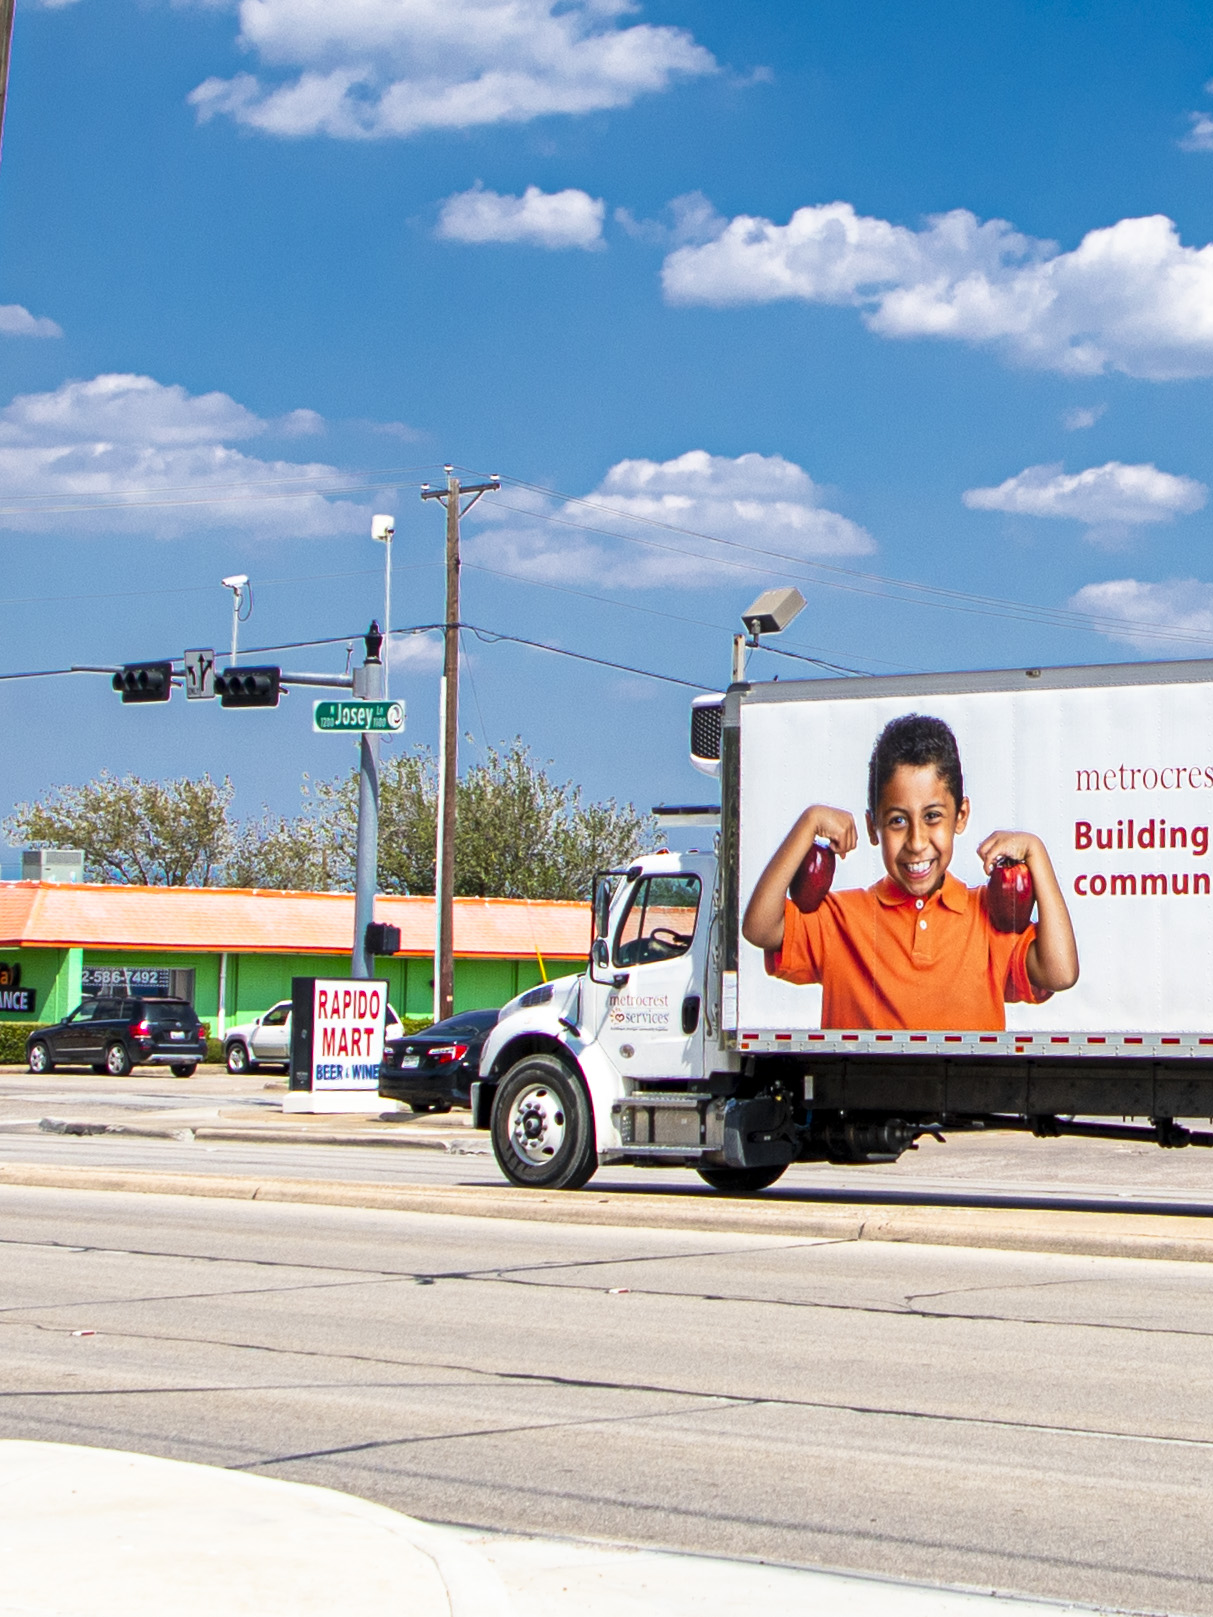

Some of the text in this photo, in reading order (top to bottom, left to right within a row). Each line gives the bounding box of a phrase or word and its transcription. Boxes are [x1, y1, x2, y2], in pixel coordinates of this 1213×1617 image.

[335, 703, 373, 729] Josey
[376, 706, 384, 715] Ln
[1074, 819, 1209, 856] Building
[318, 990, 380, 1020] RAPIDO
[609, 994, 669, 1007] metrocrest
[626, 1009, 670, 1024] services
[322, 1028, 374, 1057] MART
[316, 1064, 343, 1081] BEER
[351, 1064, 380, 1080] WINE
